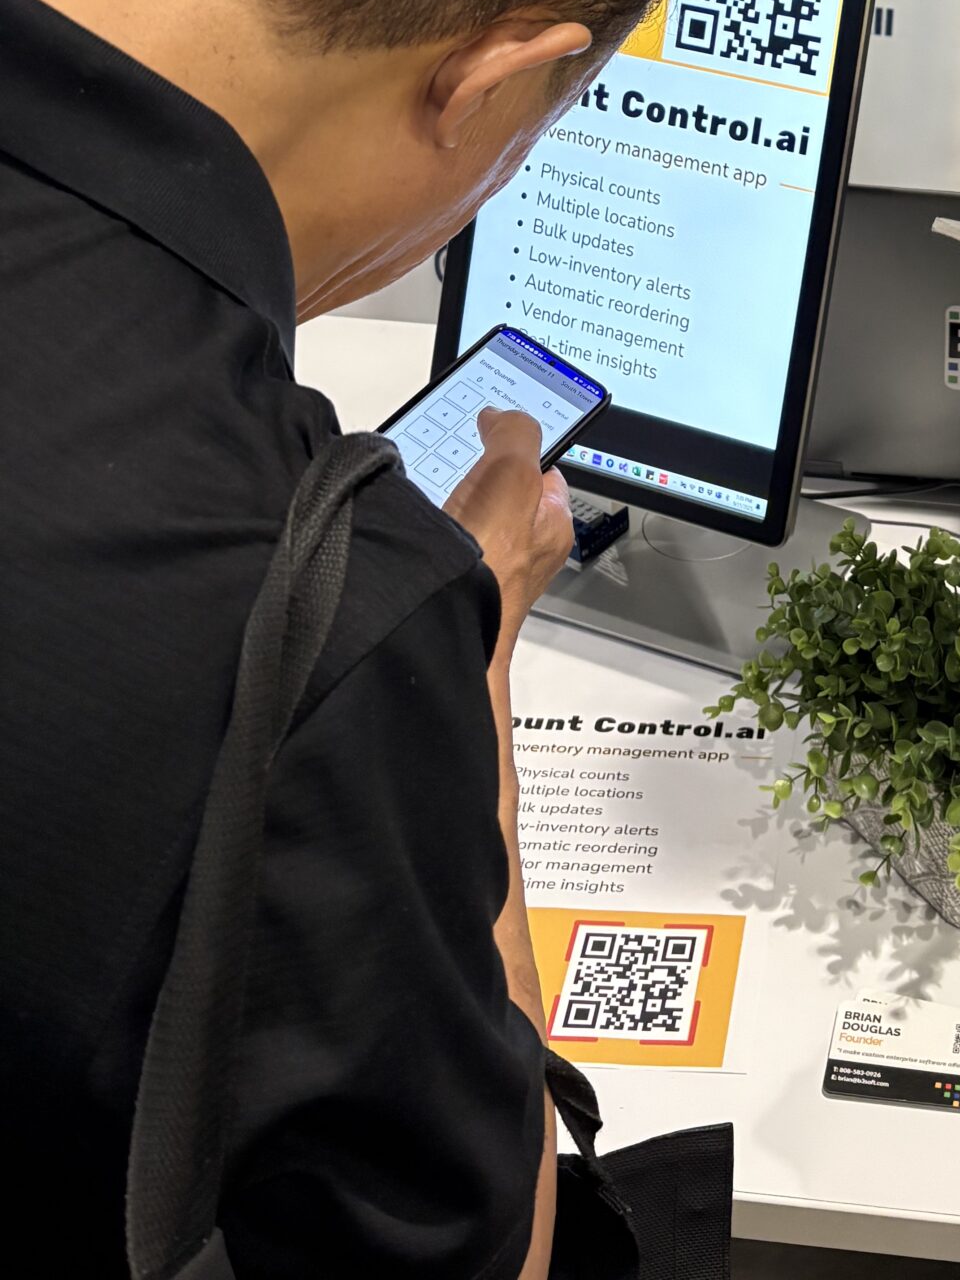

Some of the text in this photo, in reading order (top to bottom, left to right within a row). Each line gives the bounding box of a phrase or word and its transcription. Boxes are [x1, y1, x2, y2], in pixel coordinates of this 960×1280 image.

[622, 89, 811, 156] Control.ai
[544, 127, 768, 190] ventory management app
[540, 163, 662, 206] Physical counts
[536, 190, 675, 238] Multiple locations
[533, 218, 635, 257] Bulk updates
[529, 245, 691, 301] Low-inventory alerts
[525, 273, 690, 333] Automatic reordering
[522, 300, 685, 358] Vendor management
[496, 337, 555, 379] Thursday September 11
[596, 349, 657, 380] insights
[479, 359, 517, 386] Enter Quantity
[490, 386, 502, 396] PVC
[561, 380, 577, 395] South
[577, 390, 594, 404] Tower
[512, 715, 766, 740] ount Control.ai
[512, 742, 730, 762] nventory management app
[579, 769, 630, 782] counts
[519, 784, 643, 800] ultiple locations
[518, 802, 603, 816] lk updates
[519, 821, 659, 837] w-inventory alerts
[519, 840, 658, 857] omatic reordering
[545, 861, 653, 875] management
[560, 879, 625, 894] insights
[844, 1011, 882, 1024] BRIAN
[839, 1033, 883, 1047] Founder
[842, 1021, 901, 1037] DOUGLAS
[886, 1054, 918, 1063] enterprise
[919, 1058, 947, 1067] software
